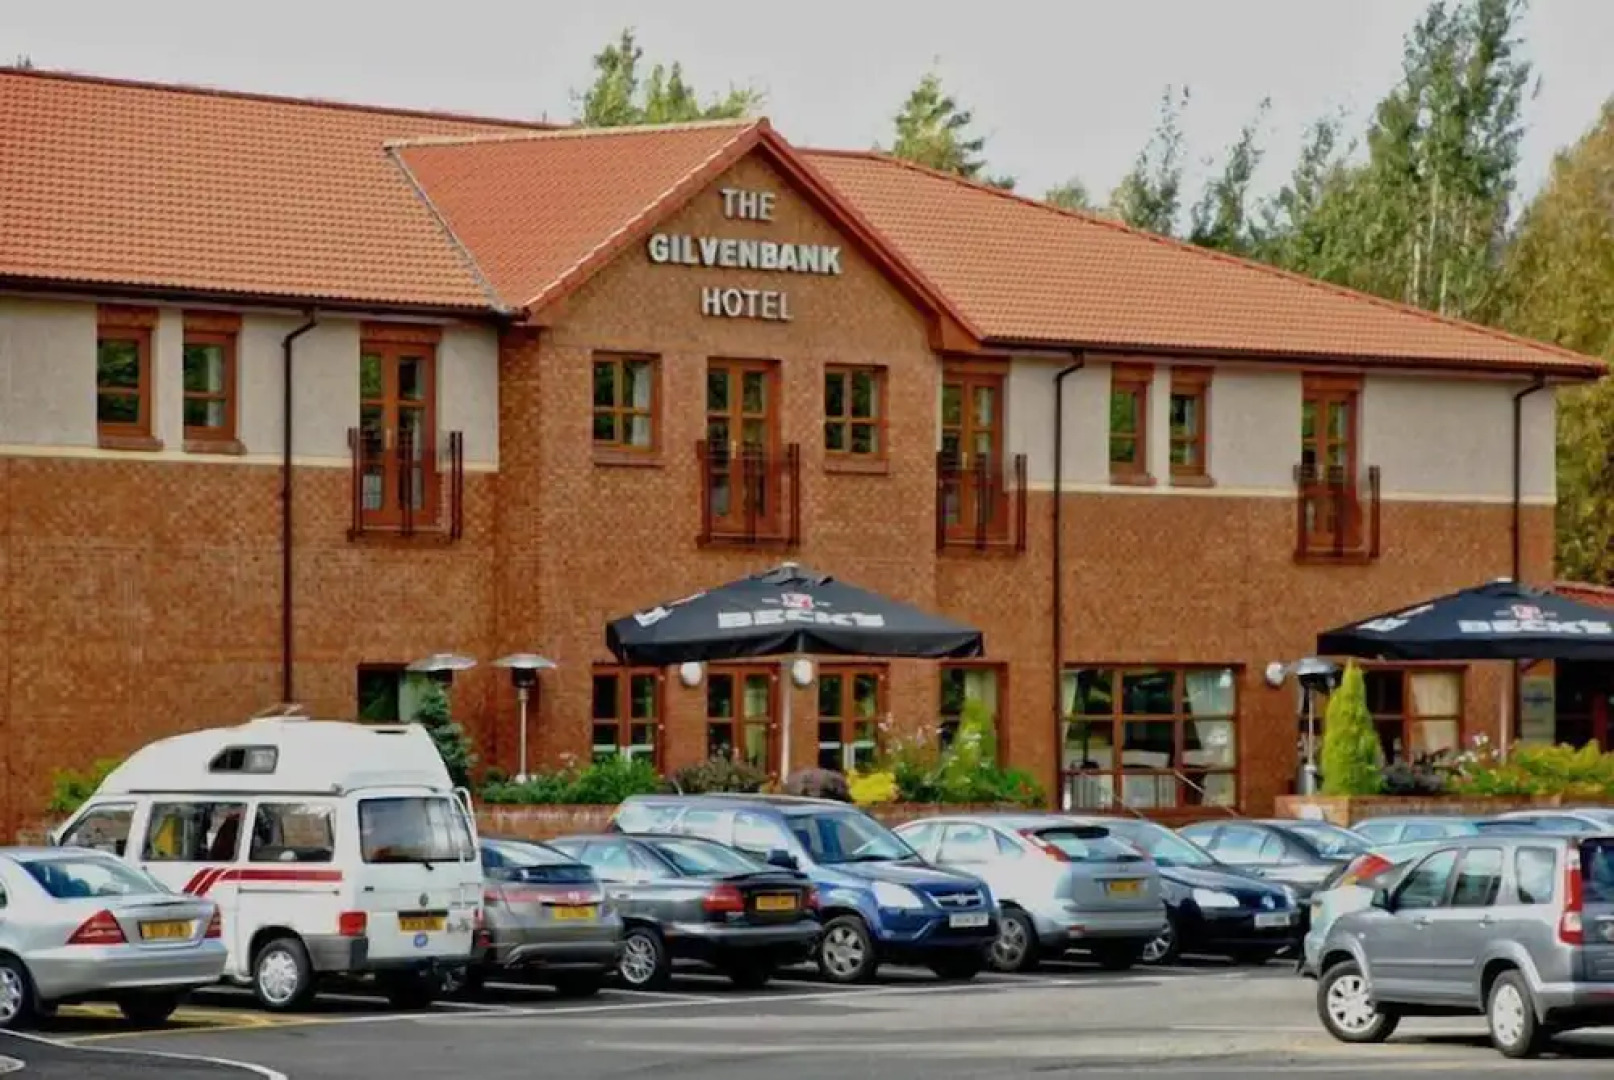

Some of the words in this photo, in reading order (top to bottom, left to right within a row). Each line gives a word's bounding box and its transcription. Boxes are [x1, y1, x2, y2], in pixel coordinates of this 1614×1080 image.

[721, 188, 776, 221] THE
[648, 233, 842, 275] GILVENBANK
[701, 286, 793, 321] HOTEL
